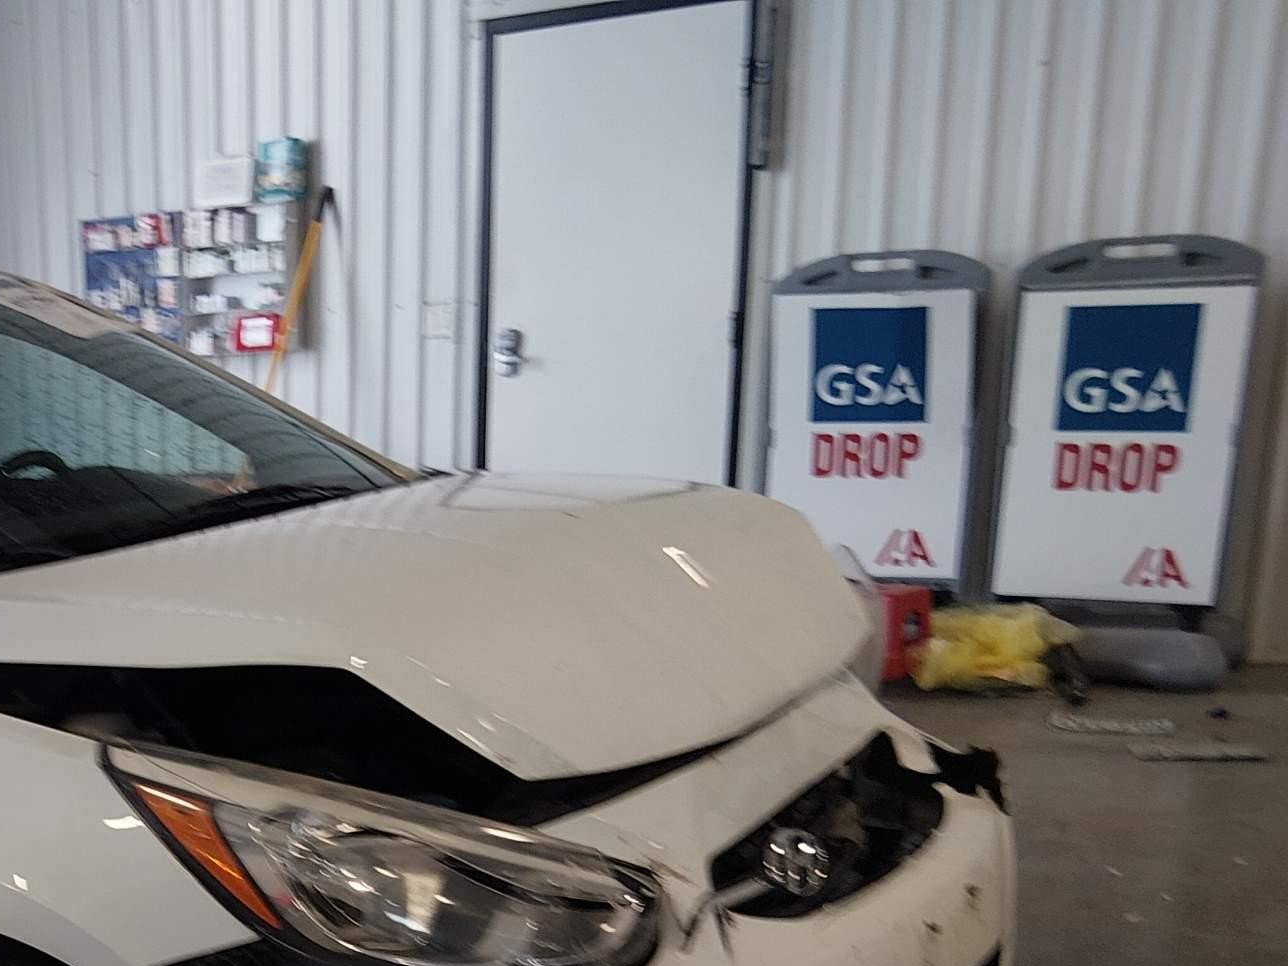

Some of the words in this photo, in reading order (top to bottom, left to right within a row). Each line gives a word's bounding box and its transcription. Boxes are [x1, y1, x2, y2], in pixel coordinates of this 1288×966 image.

[815, 363, 924, 406] GSA
[1064, 367, 1186, 413] GSA
[811, 432, 922, 478] DROP
[1053, 442, 1180, 492] DROP
